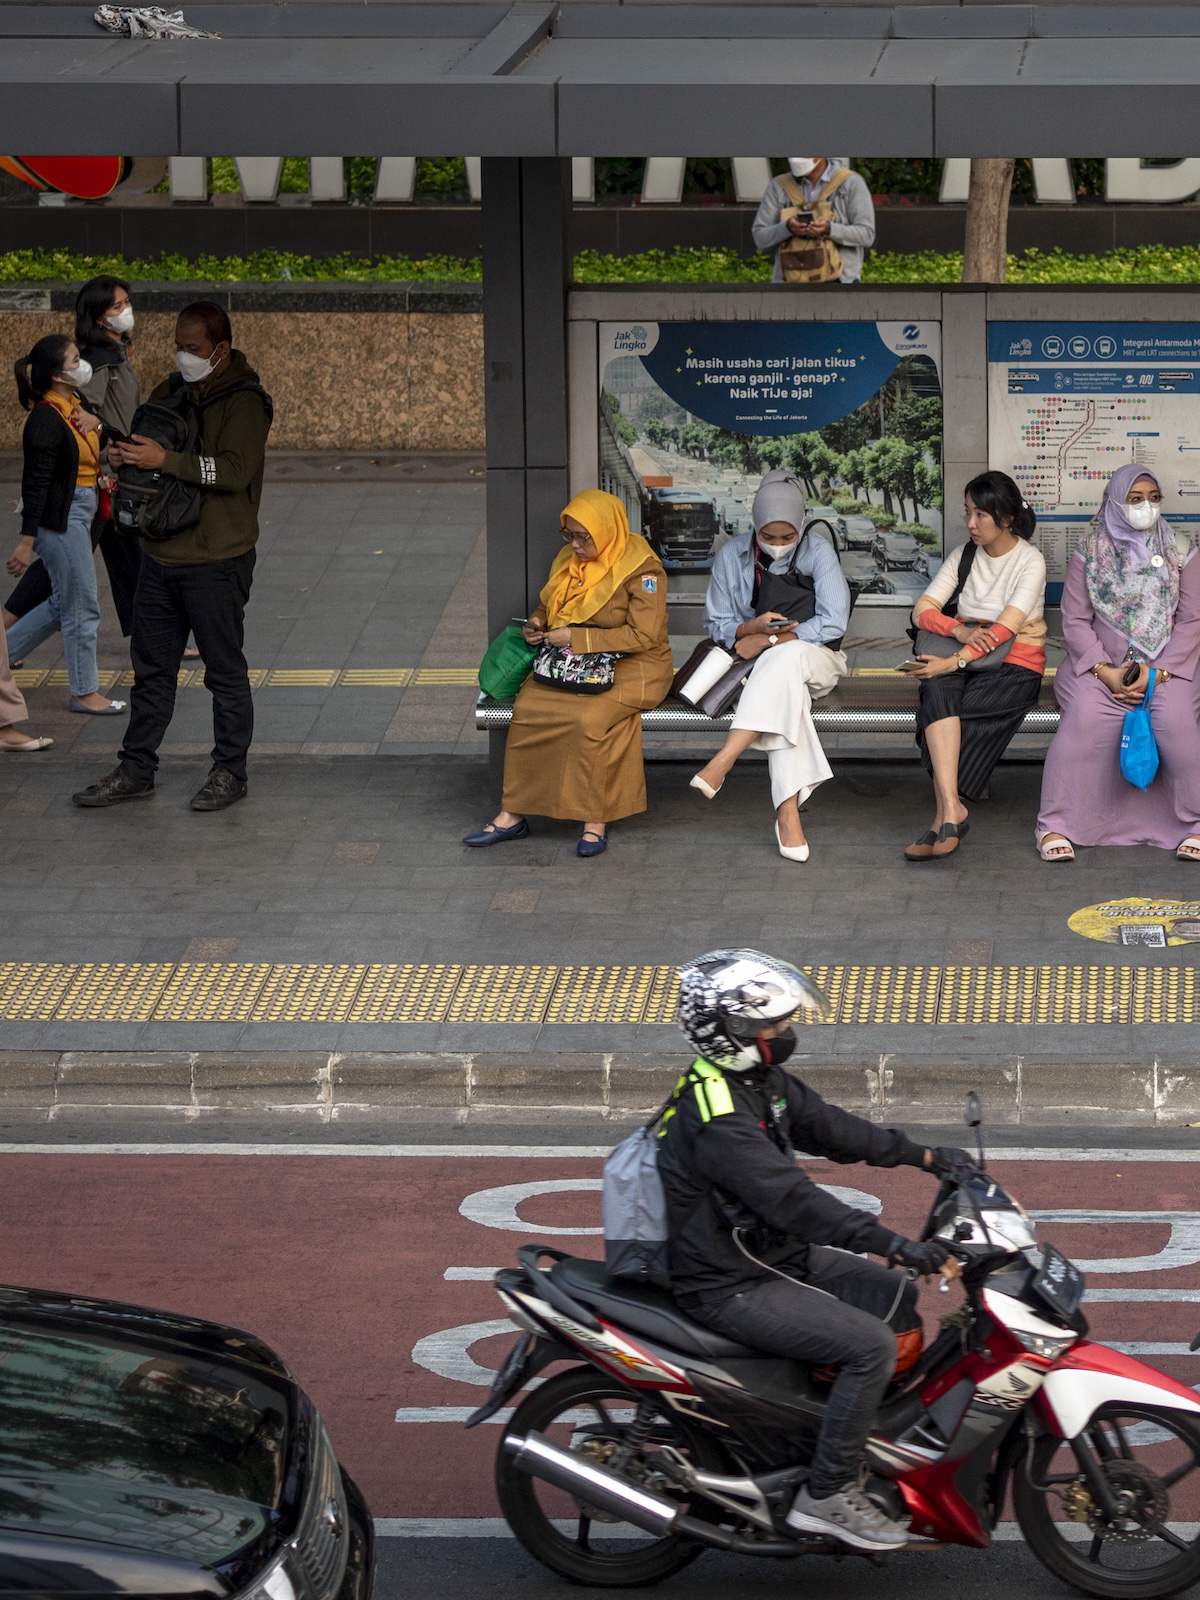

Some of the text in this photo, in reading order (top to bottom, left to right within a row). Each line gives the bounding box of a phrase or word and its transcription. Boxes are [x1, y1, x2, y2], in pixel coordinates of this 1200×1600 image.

[614, 331, 631, 341] Jak
[614, 340, 647, 351] Lingko
[1123, 339, 1153, 349] Integrasi
[1155, 339, 1192, 347] Antarmoda
[1009, 348, 1032, 356] Lingko
[686, 357, 856, 370] Masih usaha cari jalan tikus
[704, 373, 746, 384] karena
[749, 373, 783, 386] ganjil
[793, 373, 838, 385] genap?
[730, 388, 813, 400] Naik TiJe aja!
